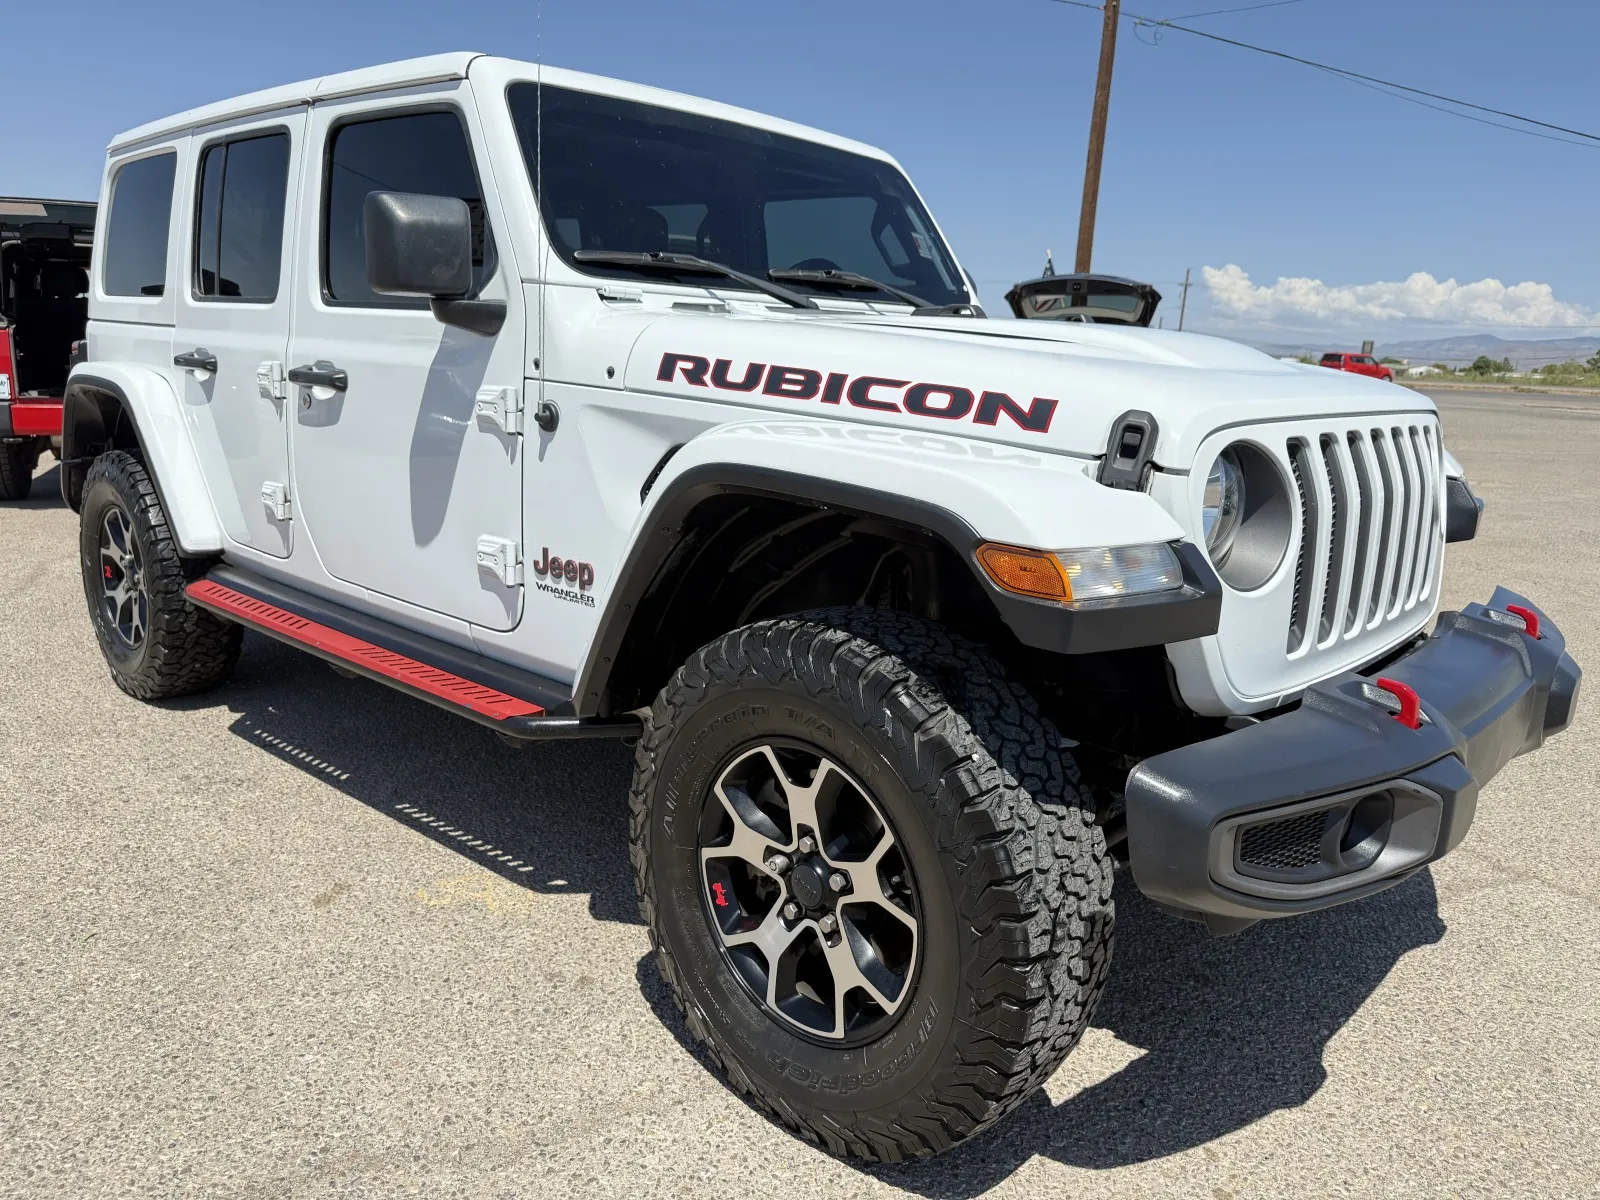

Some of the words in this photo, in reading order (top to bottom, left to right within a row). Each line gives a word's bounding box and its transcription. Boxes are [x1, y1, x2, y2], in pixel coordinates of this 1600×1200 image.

[656, 352, 1059, 433] RUBICON
[533, 546, 594, 591] Jeep
[535, 581, 595, 604] WRANGLER
[553, 593, 596, 608] UNLIMITED
